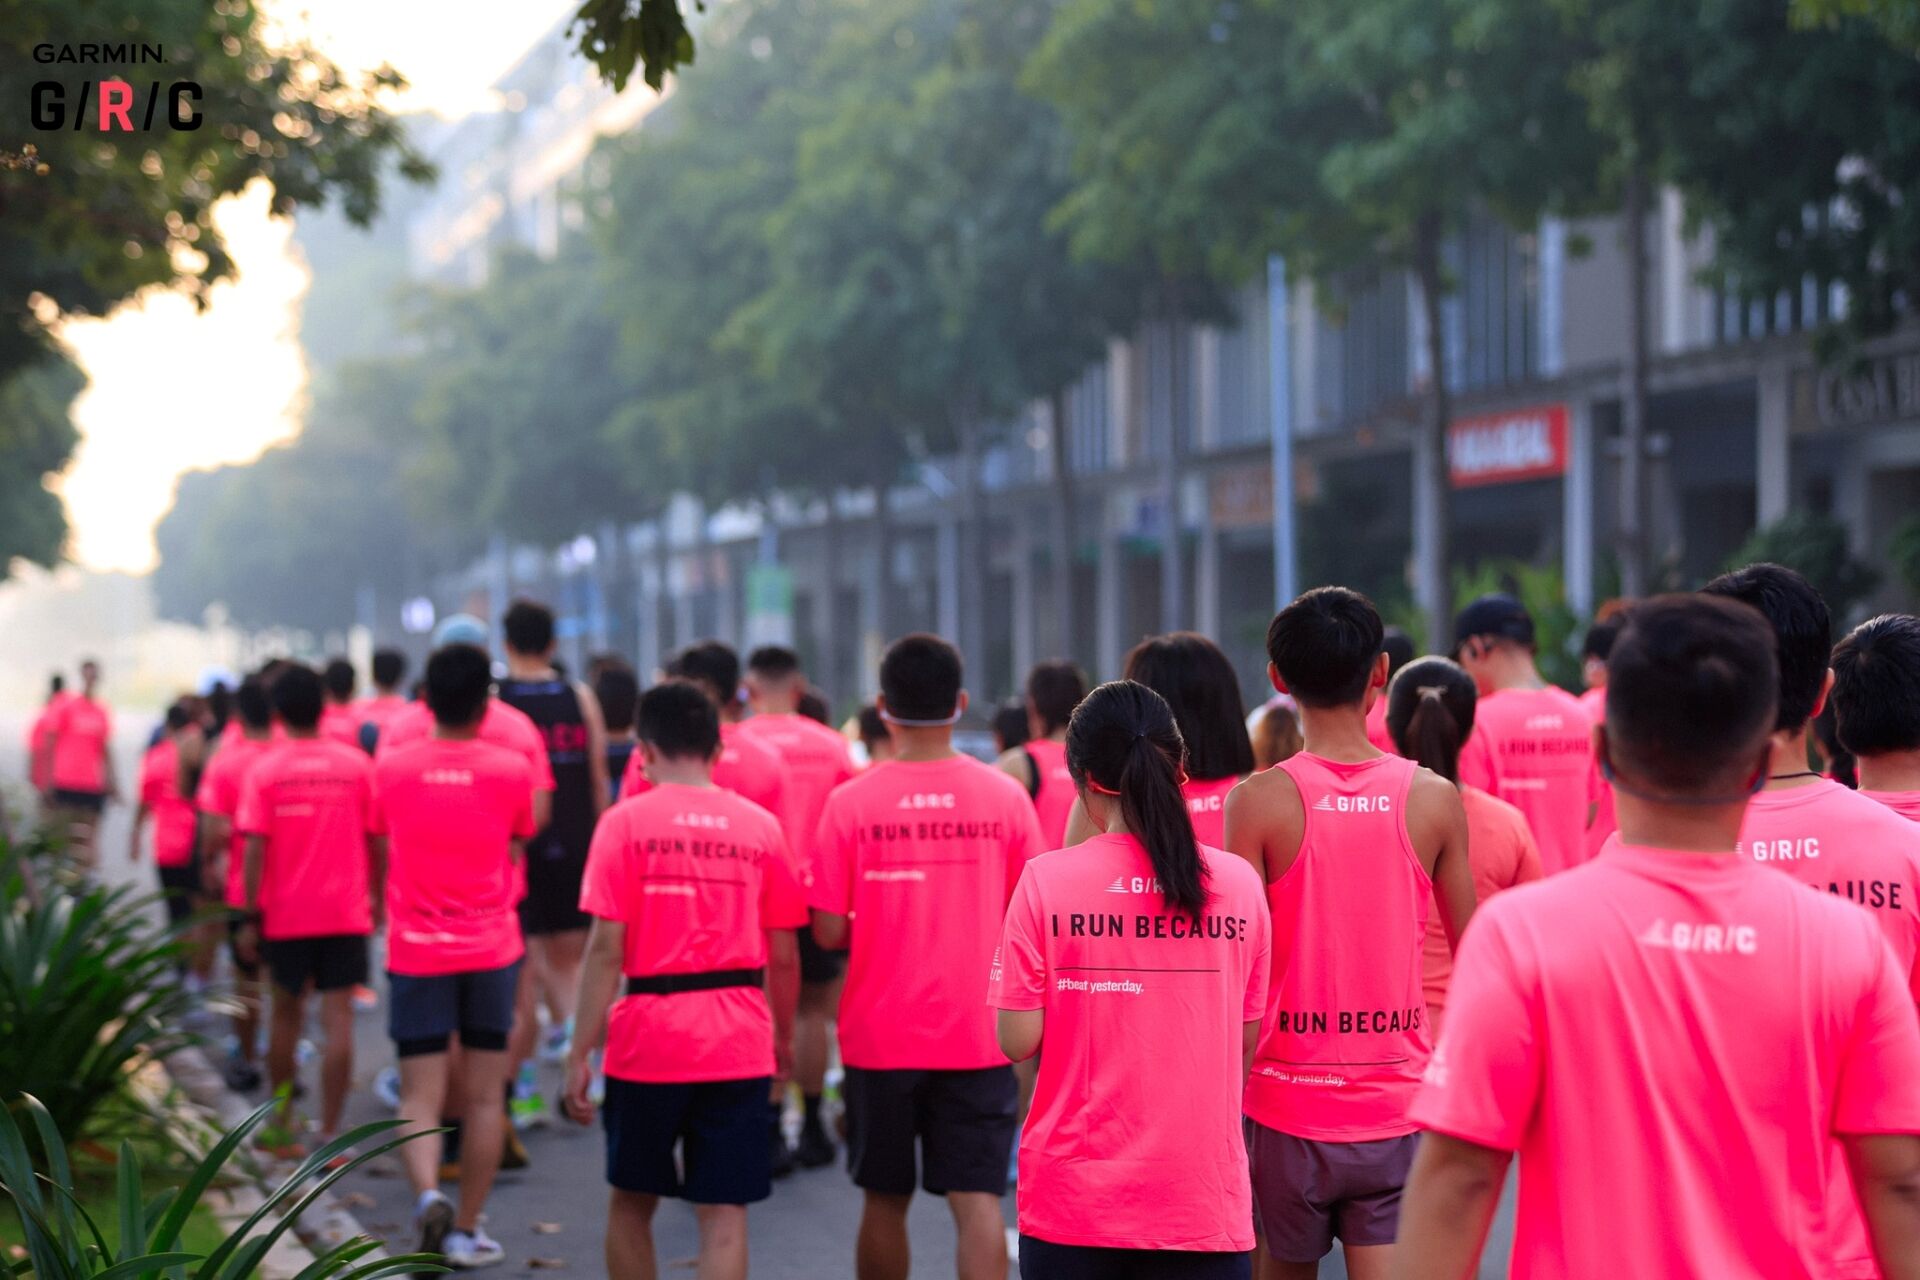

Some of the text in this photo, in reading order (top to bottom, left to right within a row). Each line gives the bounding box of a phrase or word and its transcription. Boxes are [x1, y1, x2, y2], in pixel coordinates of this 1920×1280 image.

[1337, 796, 1391, 812] G/R/C
[1752, 838, 1820, 861] G/R/C
[1052, 914, 1247, 942] I RUN BECAUSE
[1672, 922, 1757, 953] G/R/C
[1057, 978, 1144, 995] #beat yesterday.
[1279, 1010, 1327, 1034] RUN
